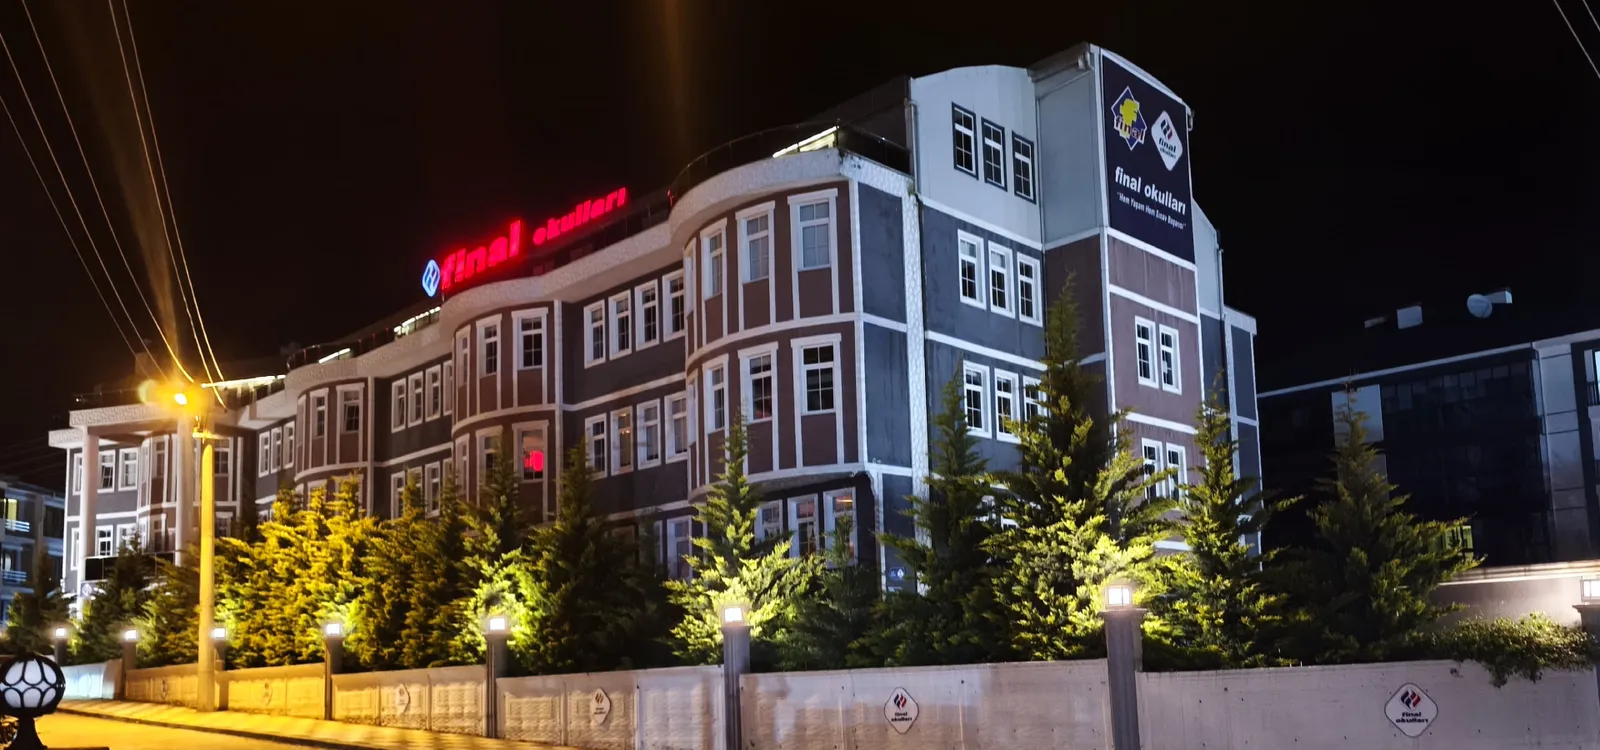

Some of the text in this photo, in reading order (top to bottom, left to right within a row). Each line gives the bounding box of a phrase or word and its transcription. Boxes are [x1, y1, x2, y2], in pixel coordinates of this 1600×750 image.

[1115, 166, 1186, 216] final okulları
[441, 220, 521, 290] final
